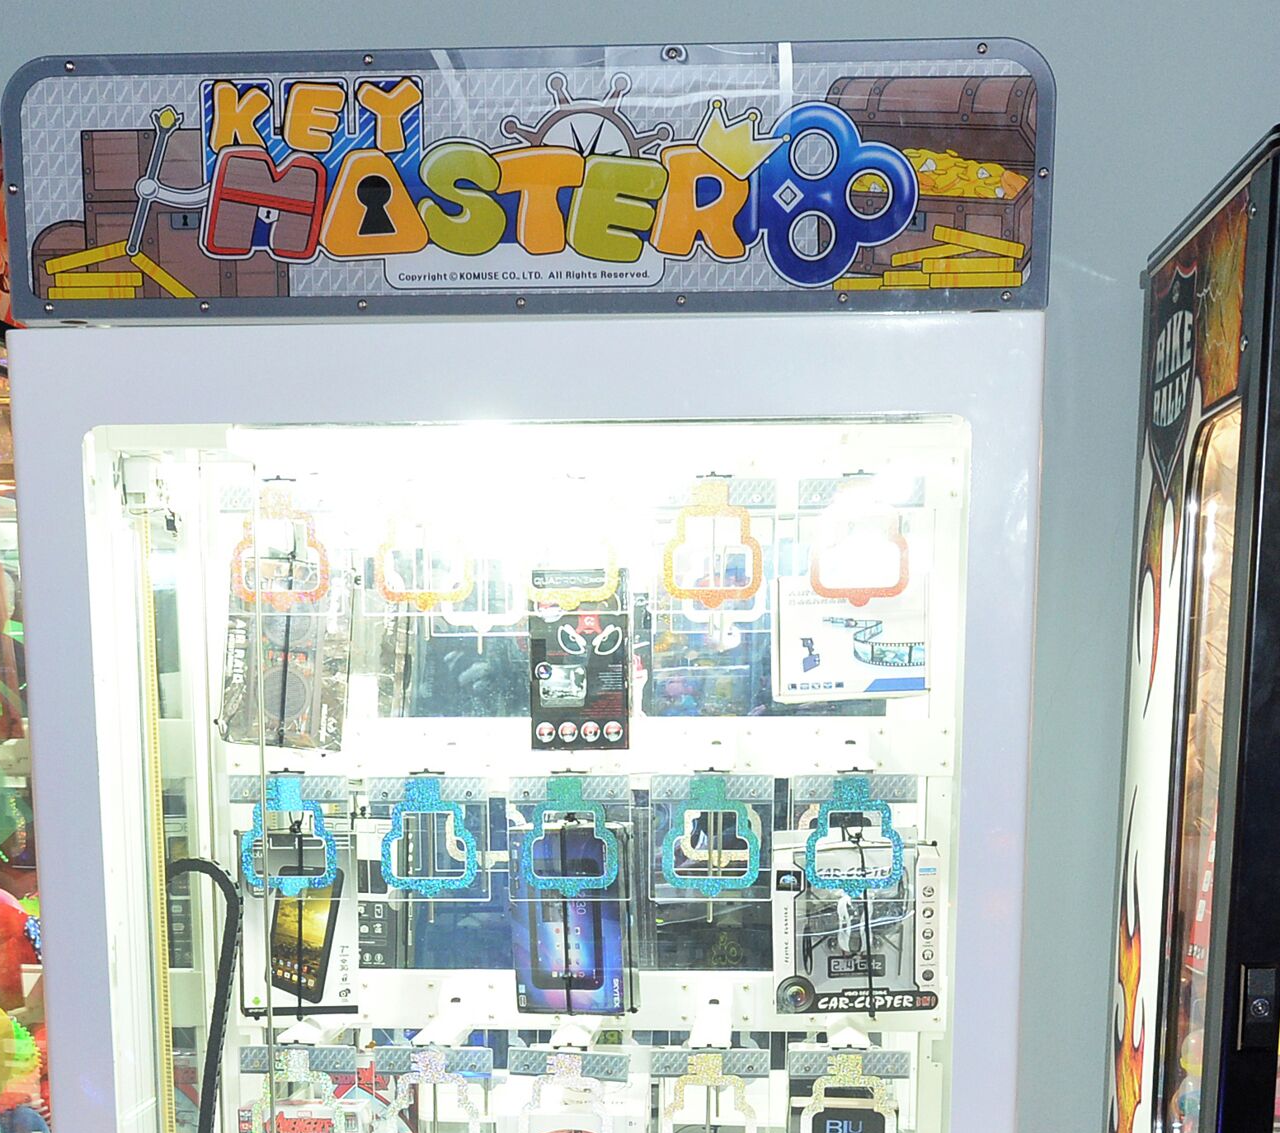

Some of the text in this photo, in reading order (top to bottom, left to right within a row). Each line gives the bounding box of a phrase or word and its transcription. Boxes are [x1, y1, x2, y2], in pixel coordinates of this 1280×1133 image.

[213, 78, 422, 152] KEY
[204, 142, 751, 263] MASTER
[398, 270, 650, 282] Copyright KOMUSE LTD. All Rights Reserved.
[1155, 309, 1193, 384] BIKE
[1152, 367, 1191, 428] RALLY
[612, 978, 620, 1008] SKYTEX
